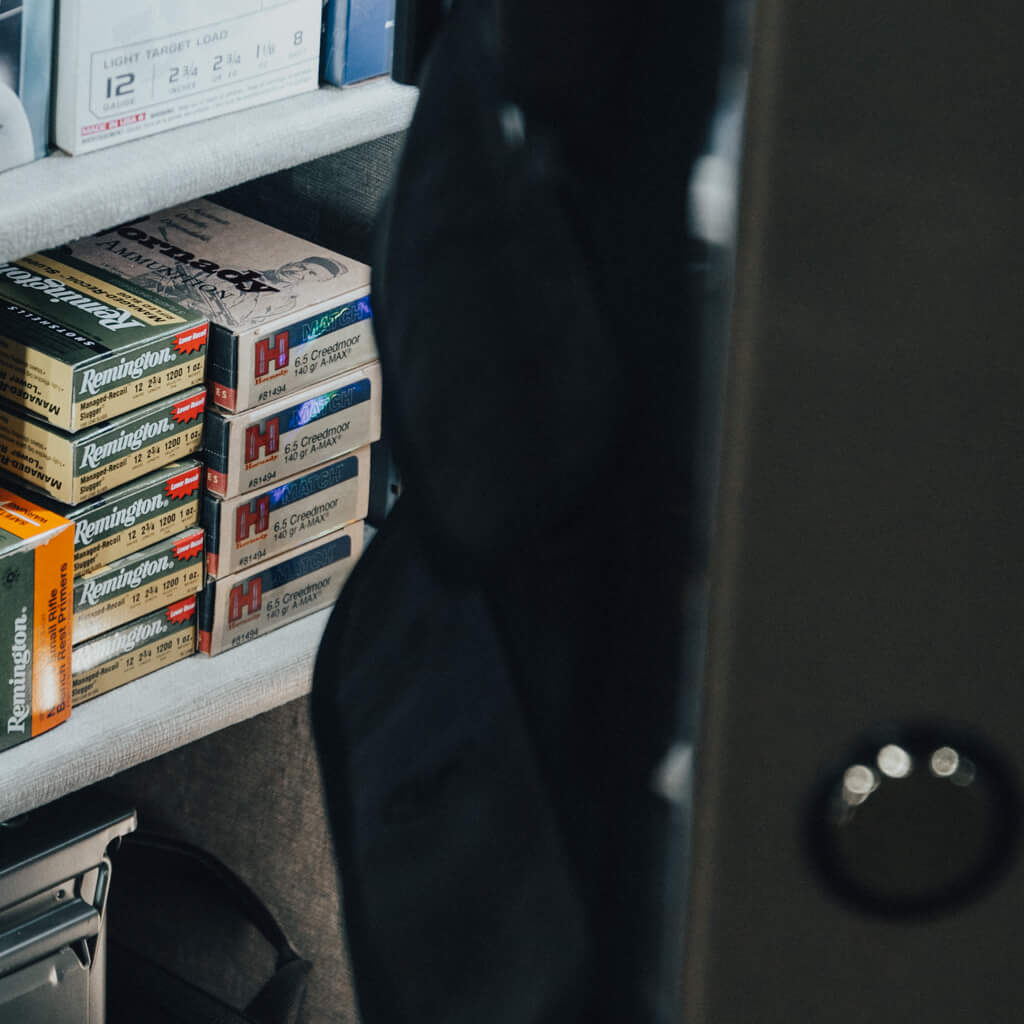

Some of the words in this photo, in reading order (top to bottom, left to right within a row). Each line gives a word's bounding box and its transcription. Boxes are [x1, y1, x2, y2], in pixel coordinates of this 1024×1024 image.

[103, 53, 140, 71] LIGHT
[145, 39, 192, 60] TARGET
[195, 30, 229, 47] LOAD
[105, 72, 136, 99] 12
[293, 29, 304, 46] 8
[103, 239, 233, 300] AMMUNITION
[117, 216, 281, 293] ornady
[7, 306, 96, 347] SHOTSHELLS
[254, 330, 290, 378] H
[294, 352, 309, 368] 6.5
[310, 334, 361, 362] Creedmoor
[294, 366, 308, 377] 140
[309, 362, 319, 374] gr
[80, 386, 128, 409] Managed-Recoil
[134, 382, 143, 393] 12
[166, 368, 183, 381] 1200
[258, 384, 287, 402] #81494
[244, 416, 280, 465] H
[284, 440, 298, 454] 6.5
[300, 421, 351, 448] Creedmoor
[80, 458, 128, 483] Managed-Recoil
[134, 453, 143, 464] 12
[164, 436, 181, 450] 1200
[284, 451, 299, 464] 140
[299, 449, 309, 460] gr
[248, 471, 277, 488] #81494
[128, 530, 137, 541] 12
[159, 513, 176, 527] 1200
[235, 495, 270, 543] H
[273, 519, 287, 533] 6.5
[289, 498, 339, 526] Creedmoor
[274, 530, 288, 542] 140
[288, 526, 297, 538] gr
[239, 549, 267, 566] #81494
[47, 589, 58, 621] Rifle
[57, 562, 68, 623] Primers
[132, 592, 141, 603] 12
[163, 576, 179, 590] 1200
[228, 576, 263, 623] H
[265, 598, 280, 612] 6.5
[282, 577, 331, 605] Creedmoor
[265, 609, 280, 621] 140
[280, 605, 289, 617] gr
[56, 627, 67, 660] Rest
[126, 656, 134, 668] 12
[156, 640, 173, 653] 1200
[231, 628, 259, 646] #81494
